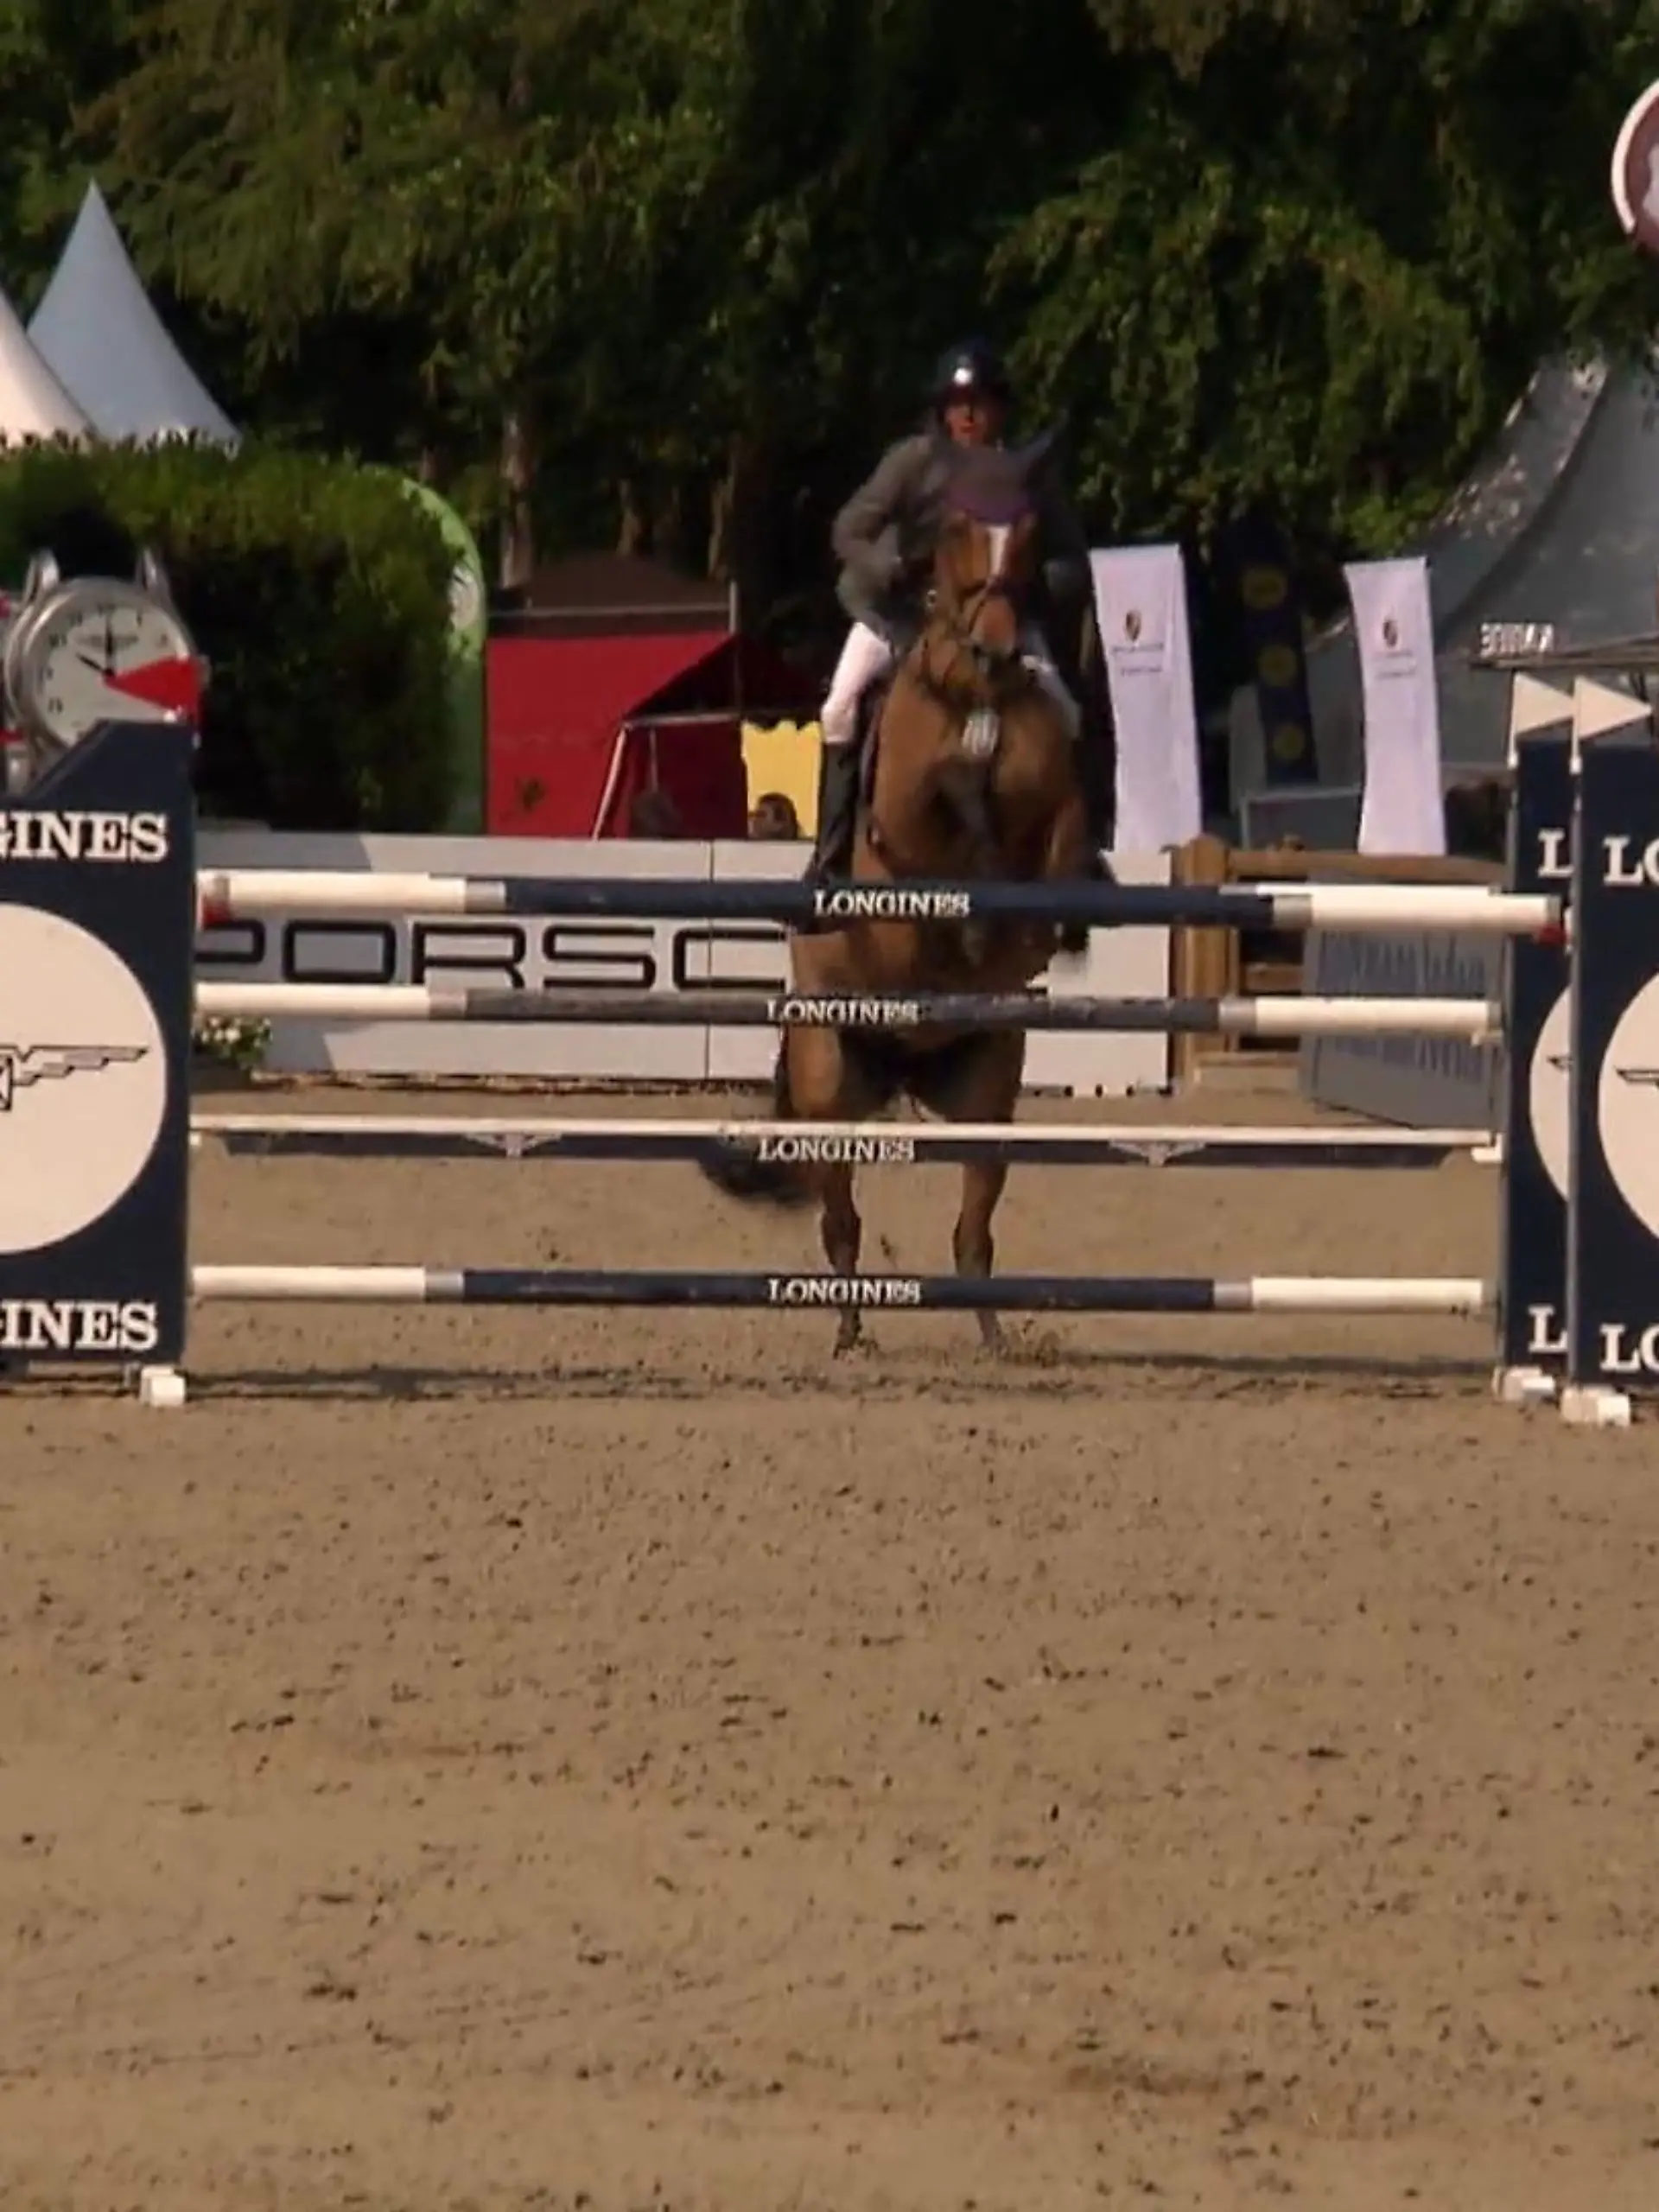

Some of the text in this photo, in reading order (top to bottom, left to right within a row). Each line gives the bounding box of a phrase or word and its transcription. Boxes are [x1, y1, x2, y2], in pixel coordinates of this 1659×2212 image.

[0, 811, 168, 861] INES
[814, 889, 969, 918] LONGINES
[767, 999, 919, 1025] LONGINES
[759, 1138, 915, 1162] LONGINES
[768, 1279, 921, 1304] LONGINES
[0, 1299, 158, 1350] INES
